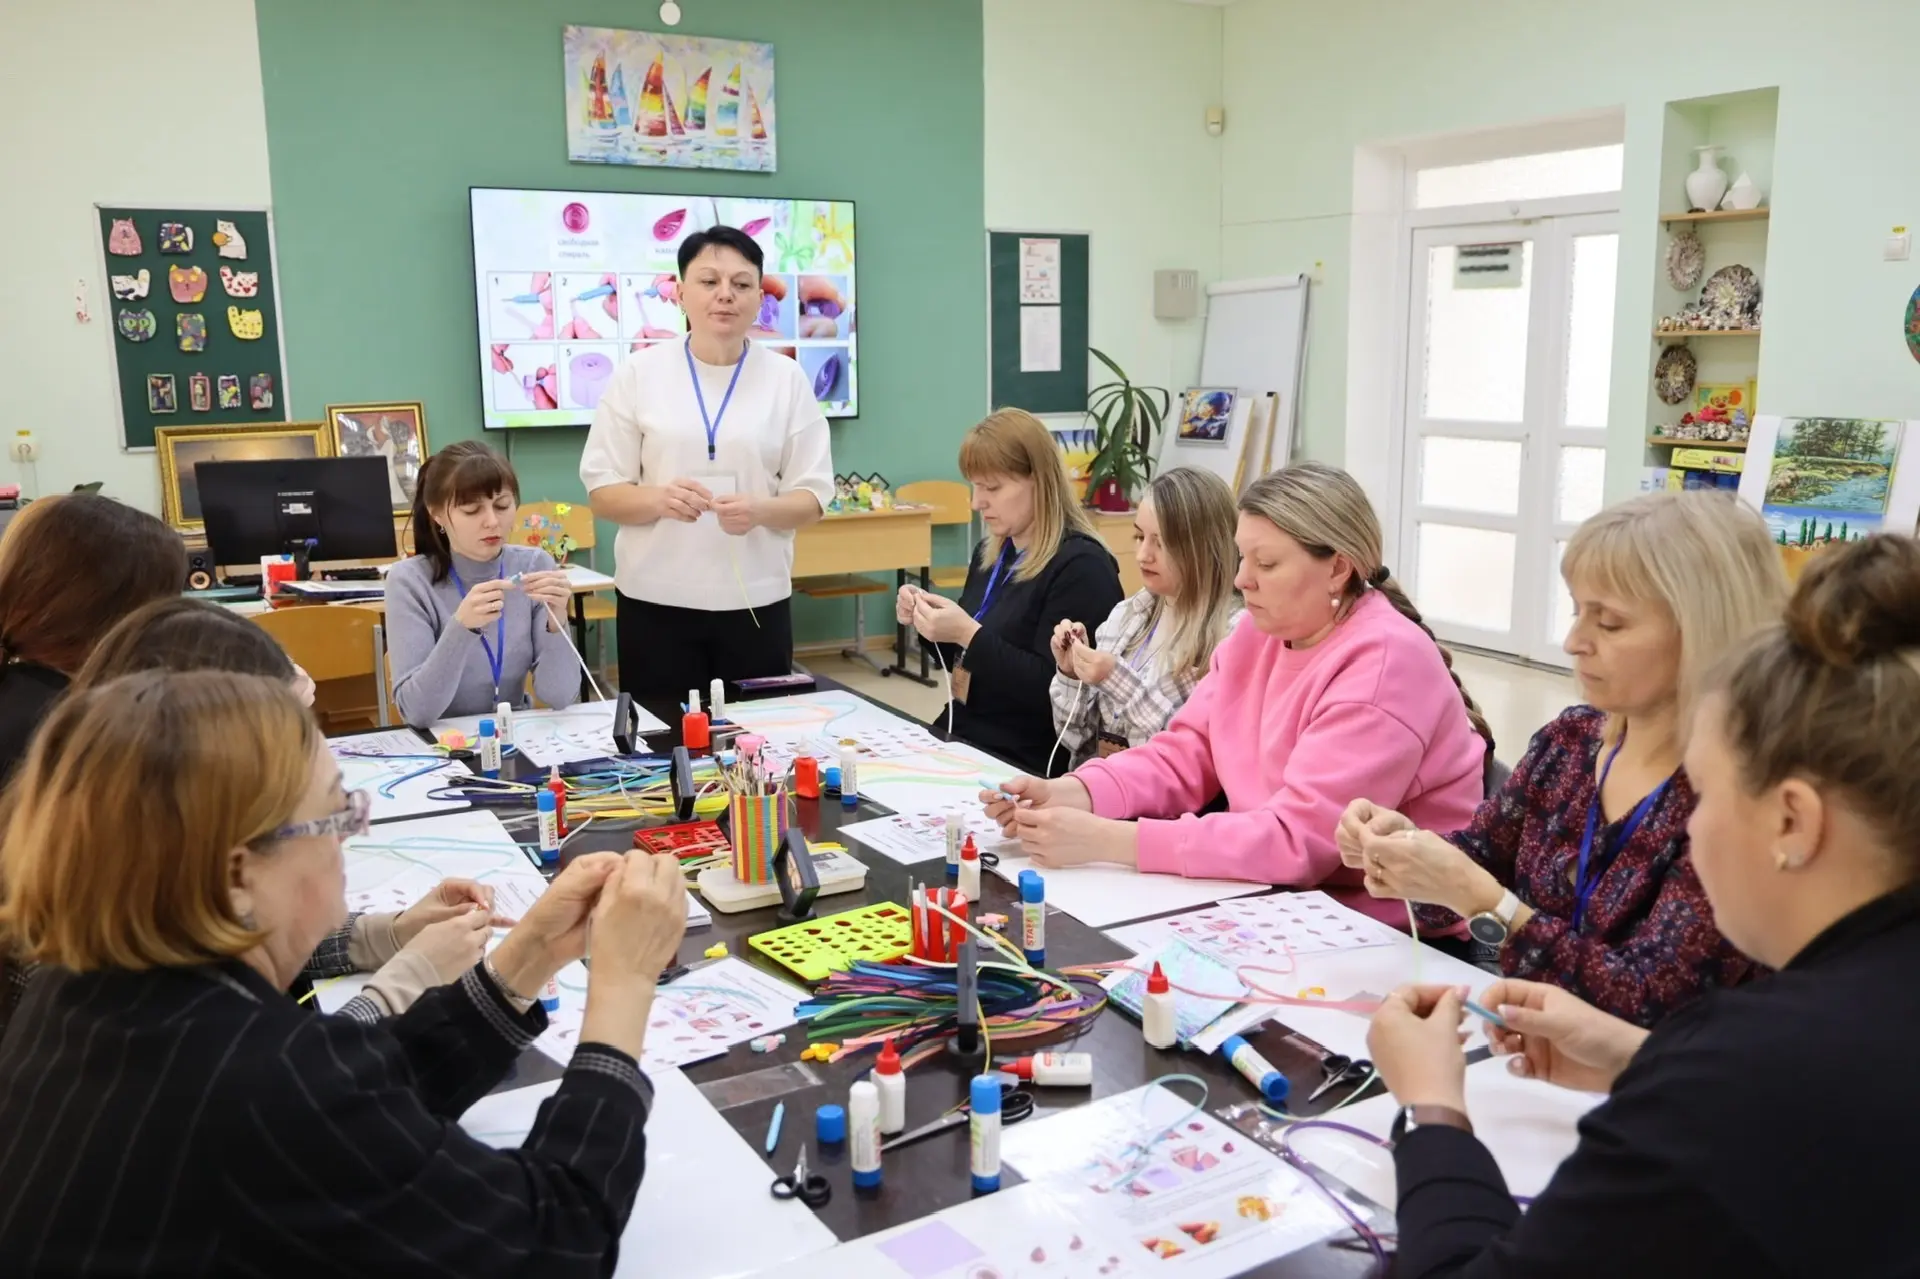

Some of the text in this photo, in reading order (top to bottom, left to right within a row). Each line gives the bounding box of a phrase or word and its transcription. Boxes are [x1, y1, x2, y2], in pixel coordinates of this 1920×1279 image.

[562, 277, 568, 287] 2
[626, 277, 632, 287] 3
[566, 348, 572, 357] 5
[548, 823, 557, 847] STAFF
